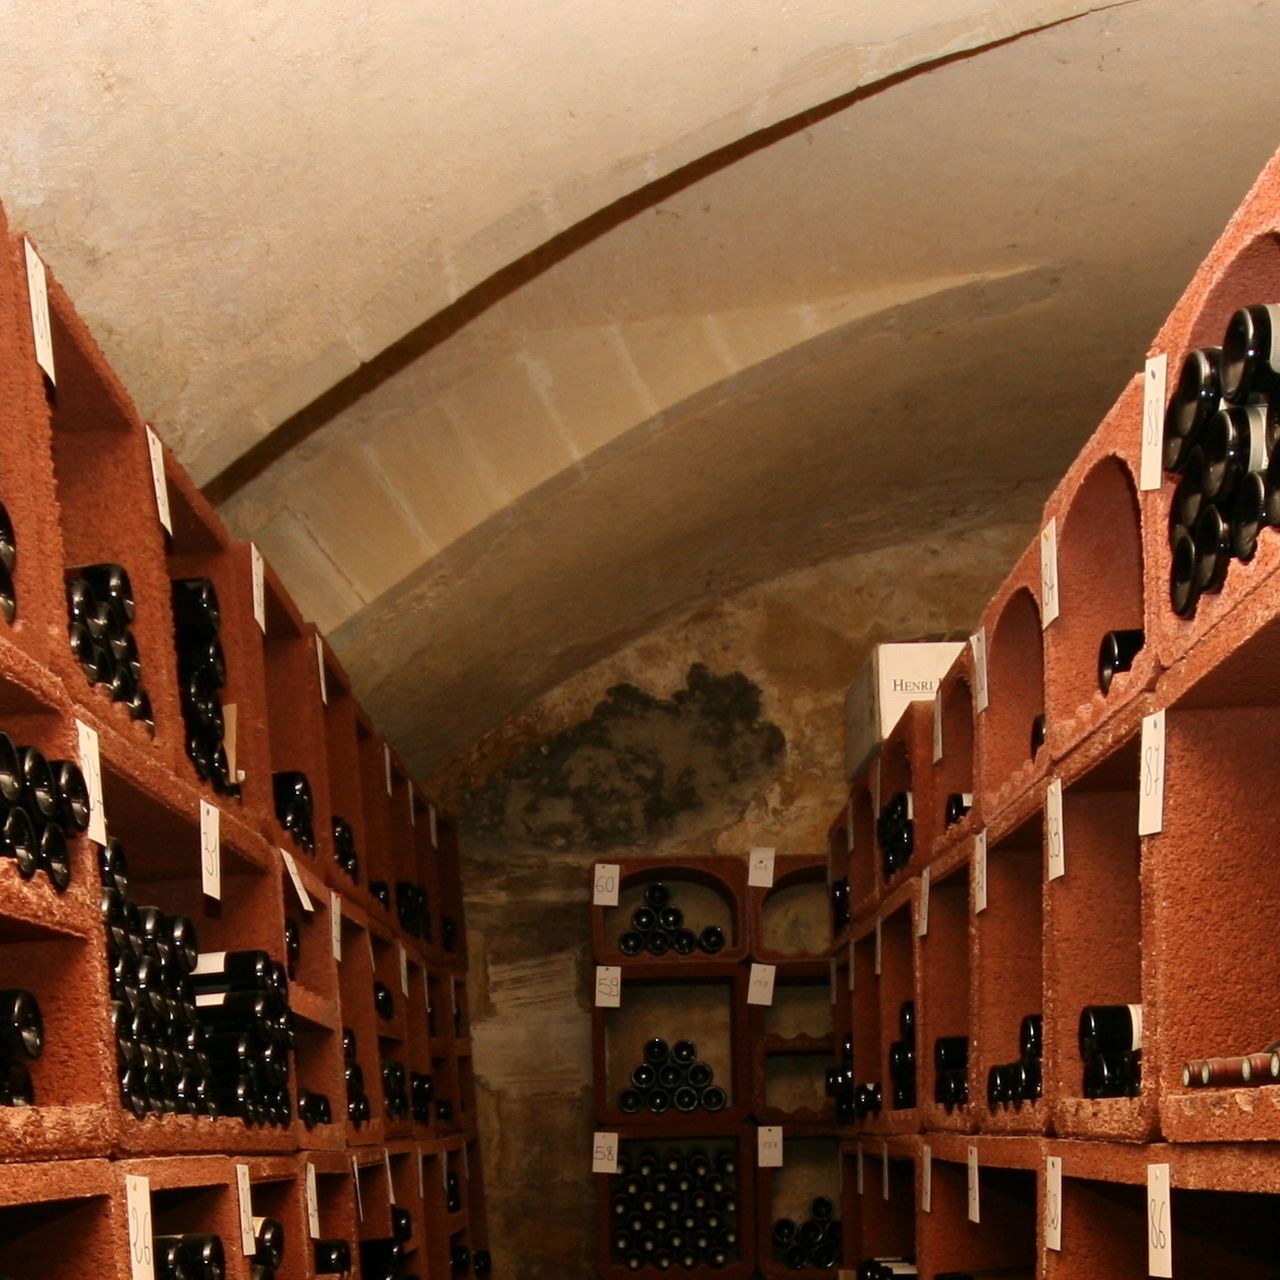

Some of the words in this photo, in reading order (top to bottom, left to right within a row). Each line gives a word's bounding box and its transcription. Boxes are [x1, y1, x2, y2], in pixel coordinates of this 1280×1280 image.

[1144, 744, 1161, 797] 87
[595, 875, 615, 894] 60
[598, 977, 619, 997] 59
[594, 1145, 614, 1161] 58
[131, 1206, 151, 1266] 26
[1150, 1197, 1167, 1250] 86
